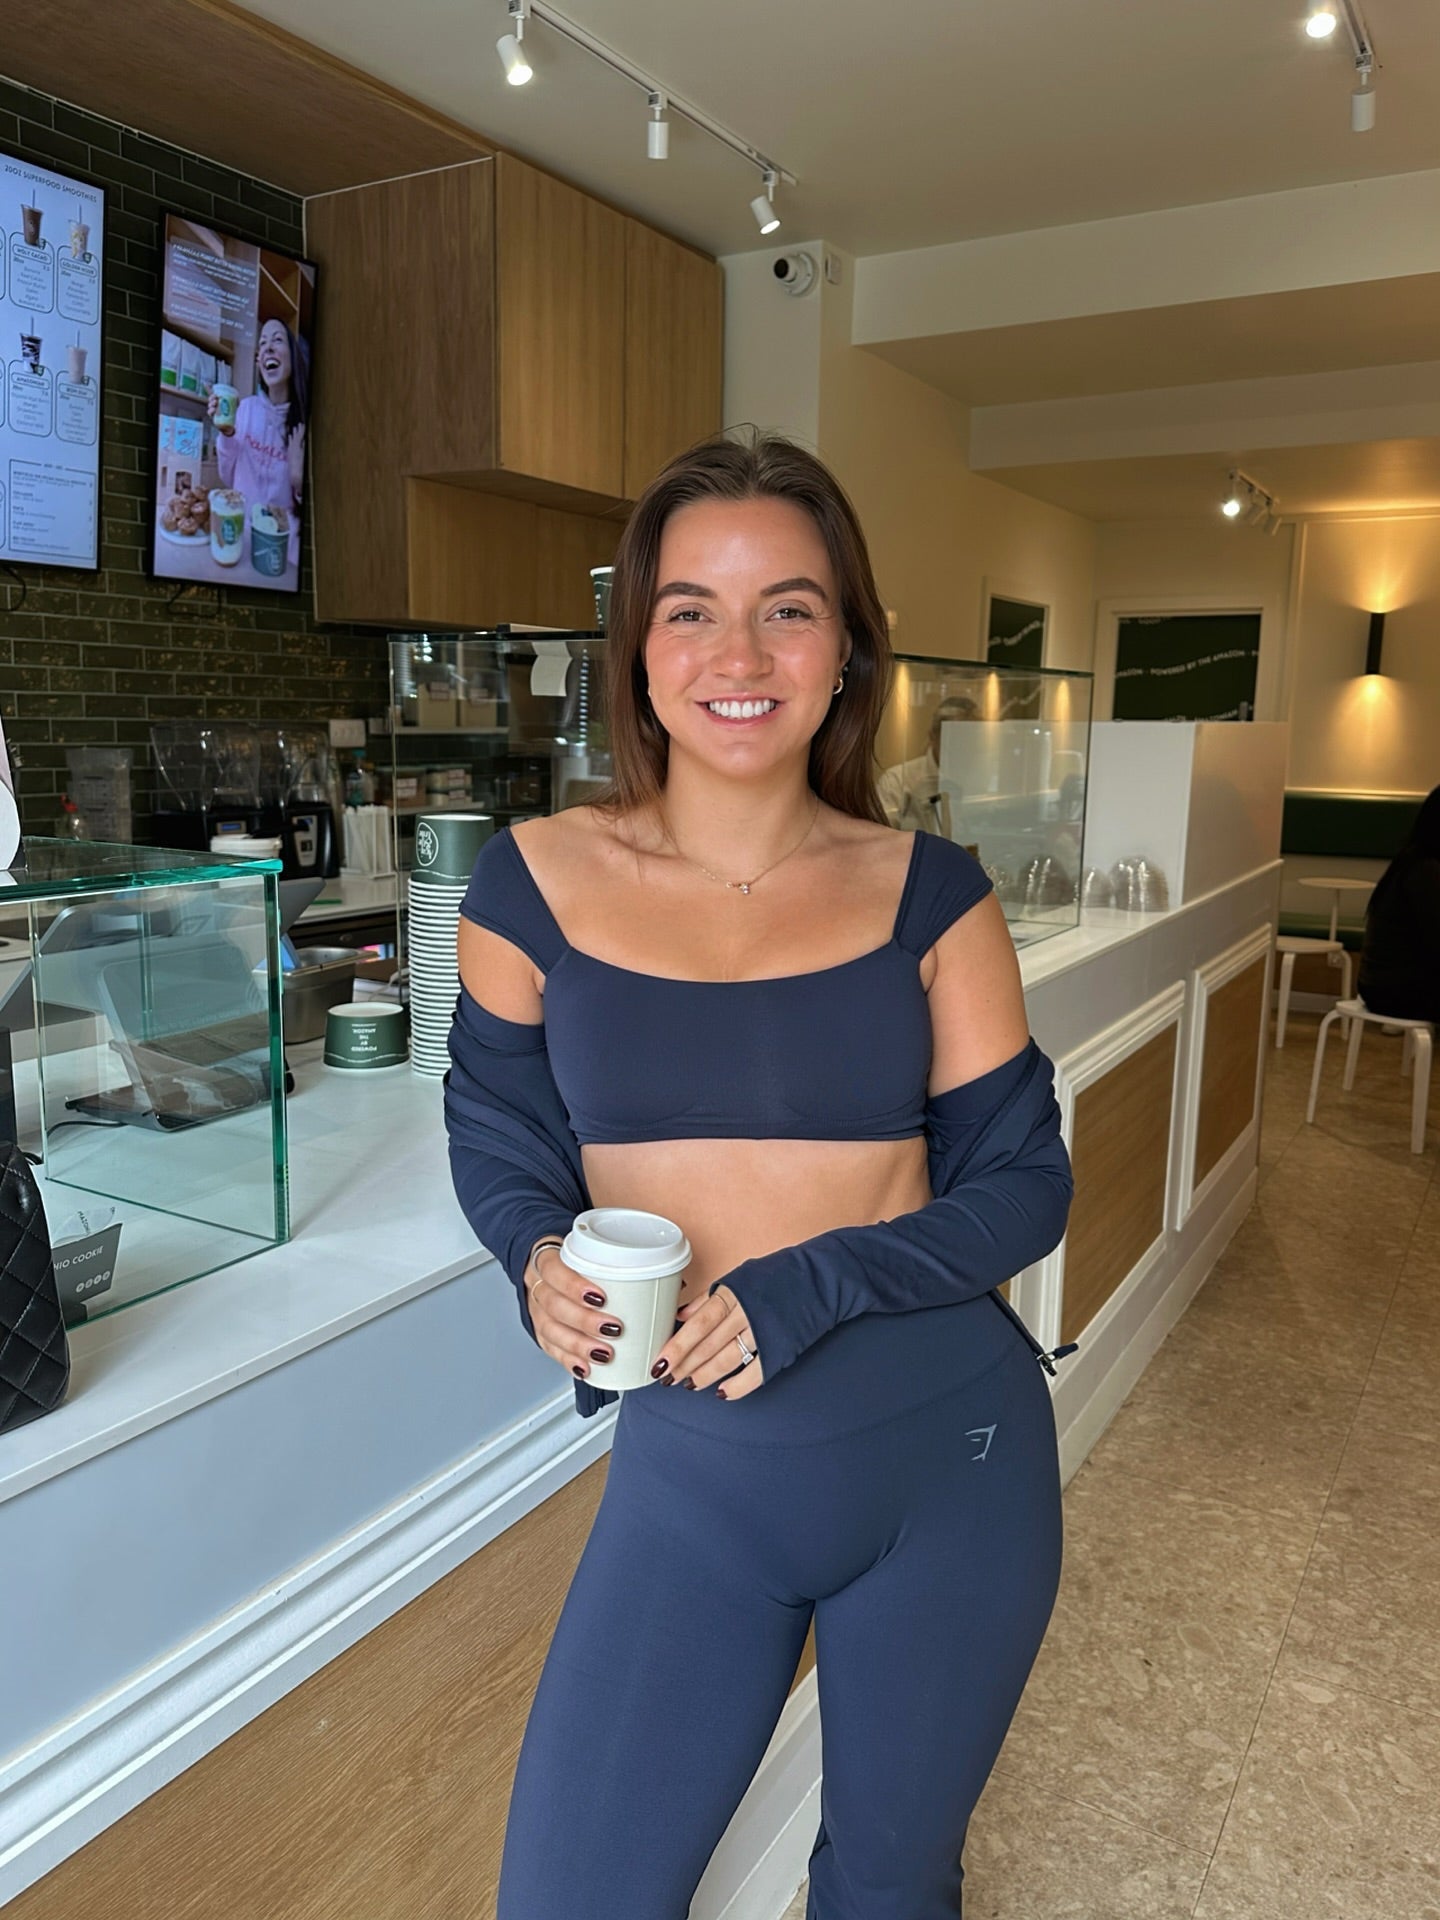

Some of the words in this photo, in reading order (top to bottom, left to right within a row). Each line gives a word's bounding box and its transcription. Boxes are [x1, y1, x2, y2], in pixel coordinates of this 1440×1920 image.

[23, 171, 61, 190] SUPERFOOD
[62, 184, 97, 203] SMOOTHIES
[1150, 665, 1186, 676] POWERED
[1186, 661, 1197, 670] BY
[1198, 655, 1211, 666] THE
[1213, 649, 1245, 661] AMAZON
[72, 1245, 104, 1265] COOKIE
